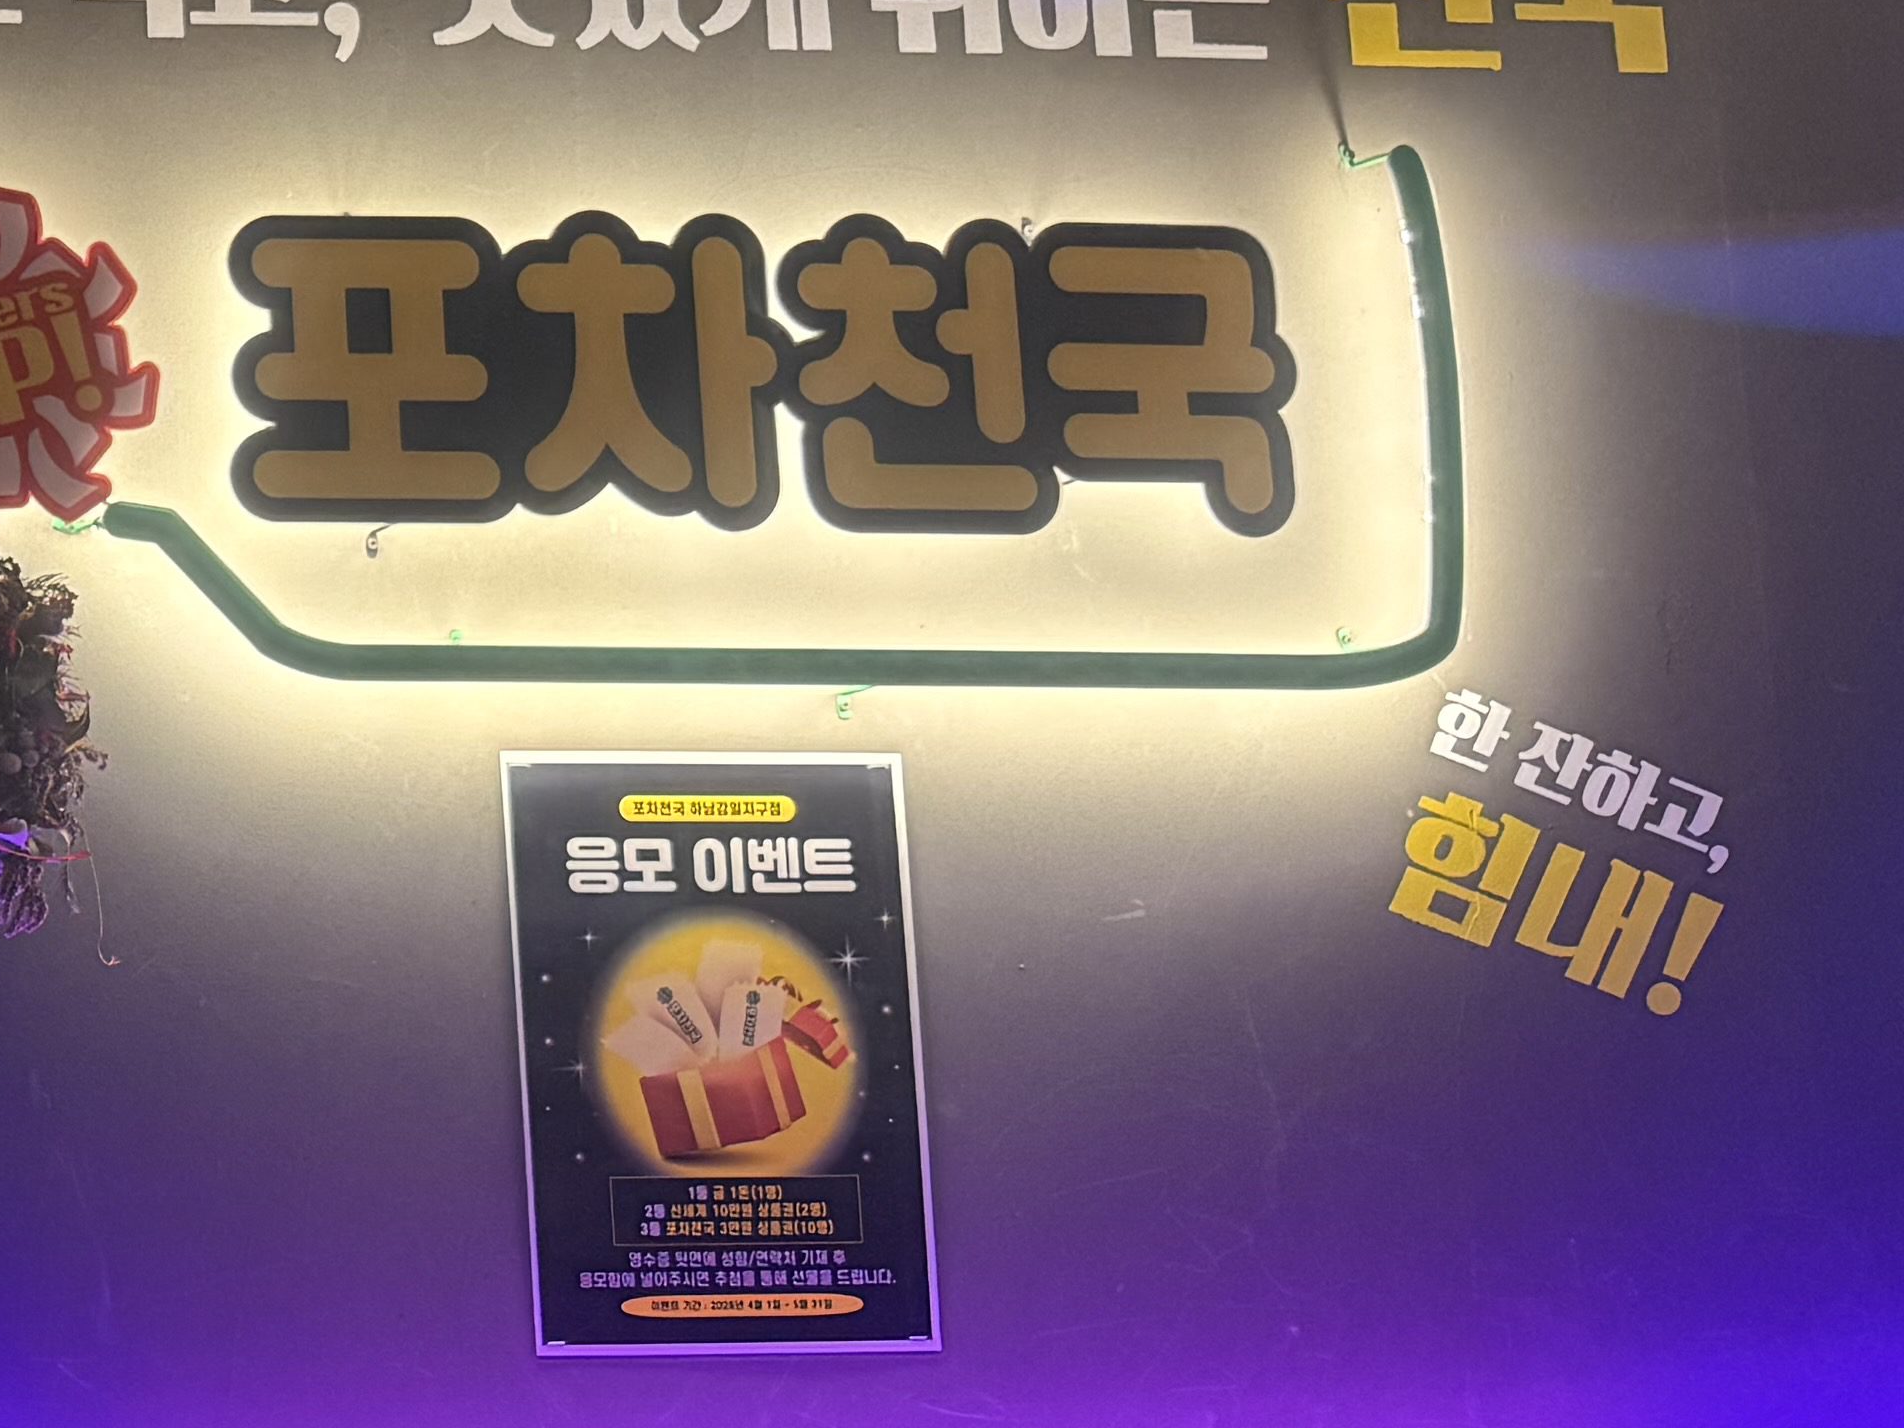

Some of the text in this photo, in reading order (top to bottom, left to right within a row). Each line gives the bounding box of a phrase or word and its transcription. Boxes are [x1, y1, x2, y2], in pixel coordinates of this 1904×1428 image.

[238, 218, 1290, 525] 포차천국
[565, 836, 857, 894] 응모 이벤트
[633, 801, 685, 816] 포차천국
[1430, 688, 1730, 874] 한 잔하고,
[1389, 791, 1724, 1016] 힘내!
